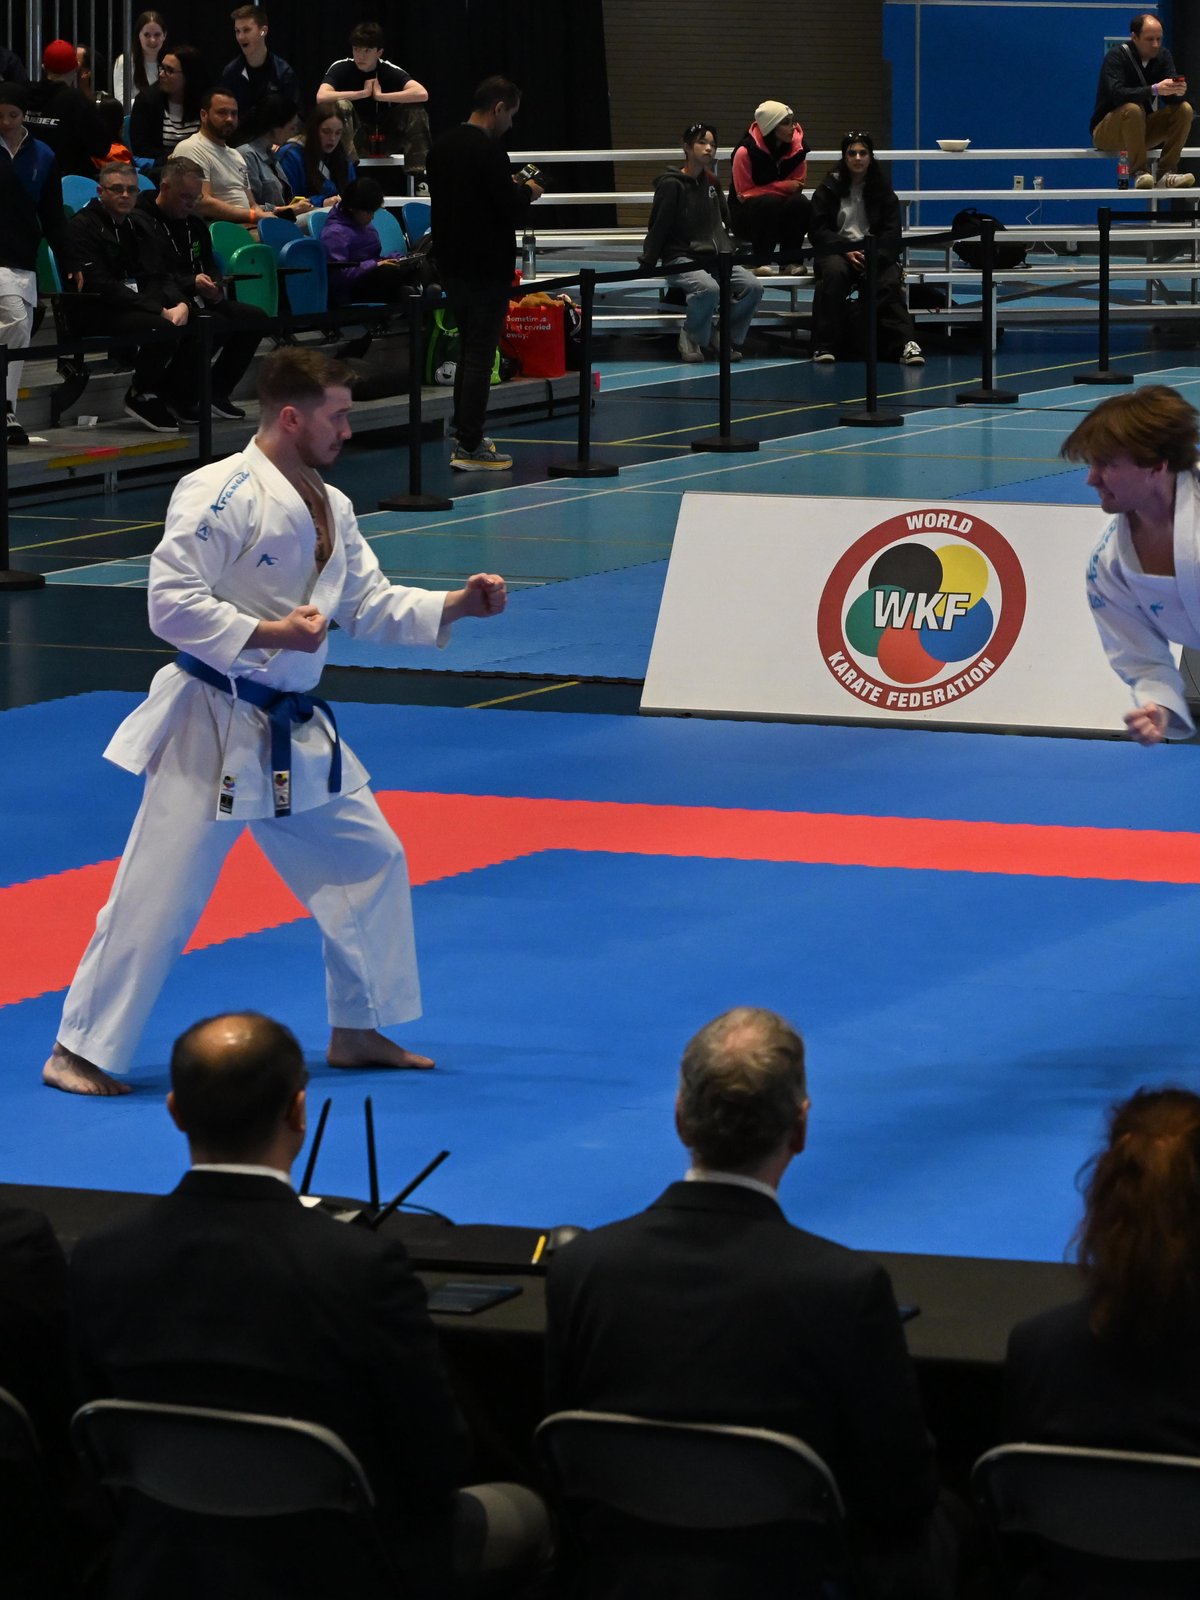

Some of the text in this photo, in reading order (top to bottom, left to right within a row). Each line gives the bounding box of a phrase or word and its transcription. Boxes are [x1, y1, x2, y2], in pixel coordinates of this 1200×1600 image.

[906, 513, 973, 534] WORLD
[873, 590, 972, 631] WKF
[827, 650, 883, 703] KARATE
[886, 657, 996, 707] FEDERATION
